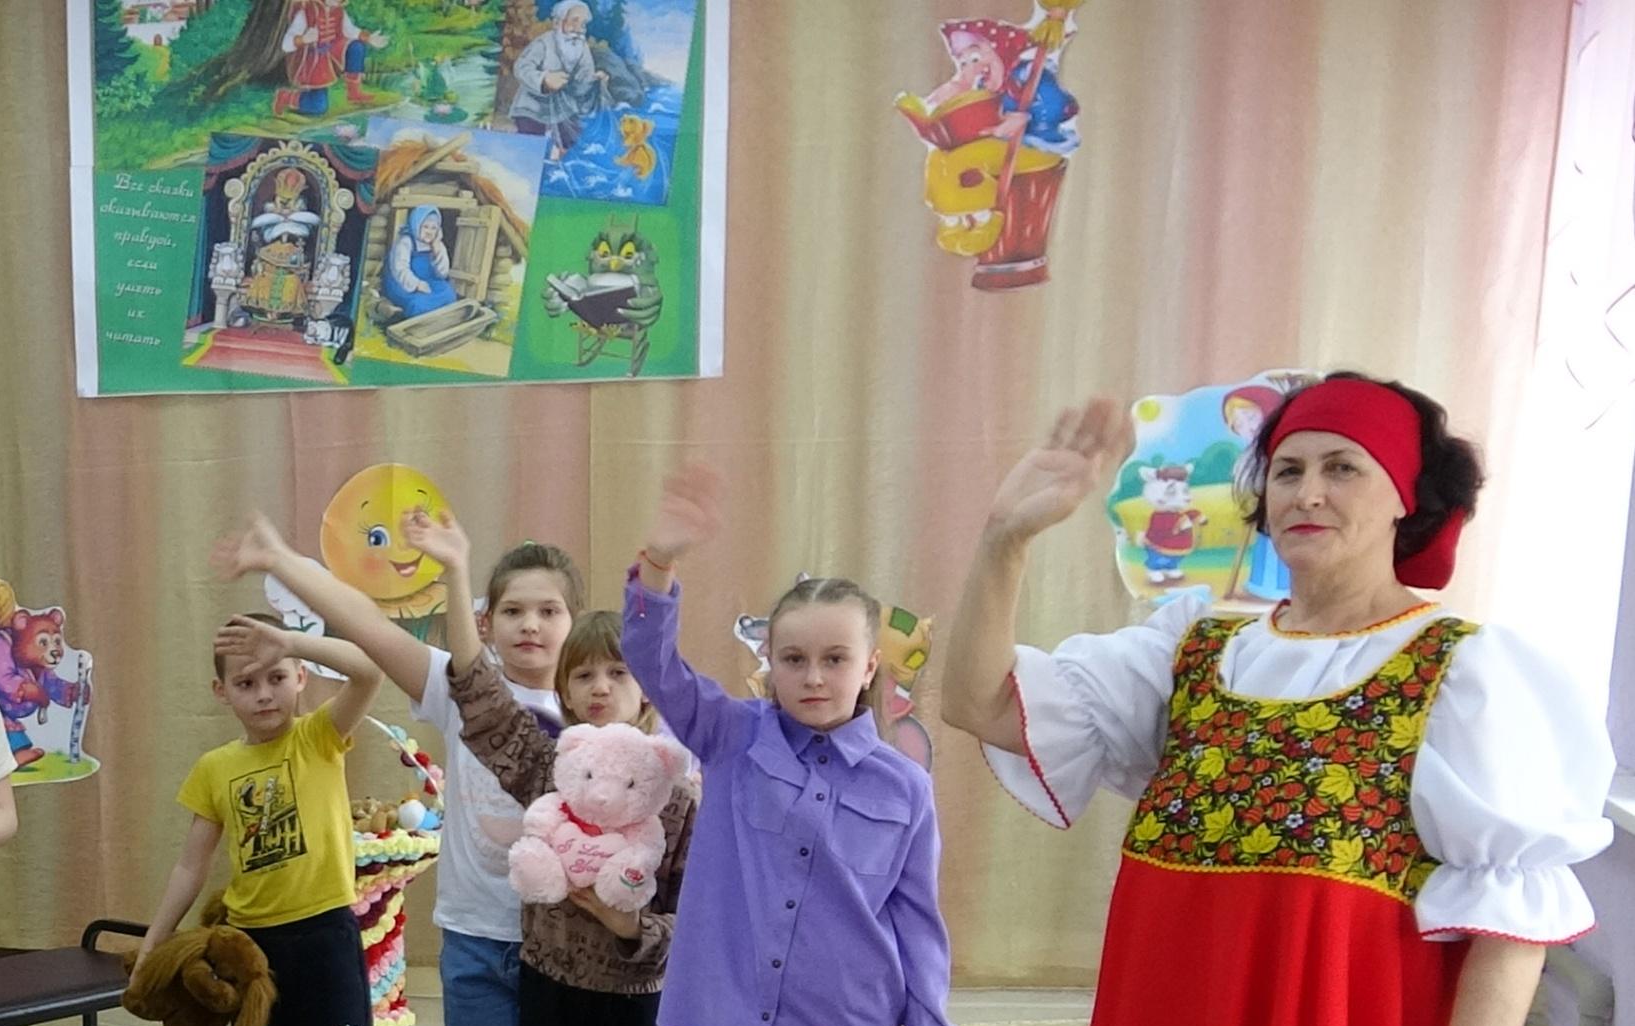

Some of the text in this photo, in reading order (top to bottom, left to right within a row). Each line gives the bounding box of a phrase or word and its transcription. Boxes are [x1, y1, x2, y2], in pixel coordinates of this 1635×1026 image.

[113, 172, 194, 197] Все сказки
[99, 197, 196, 223] оказываются
[127, 258, 157, 270] если
[127, 308, 147, 318] их
[105, 331, 162, 345] читать
